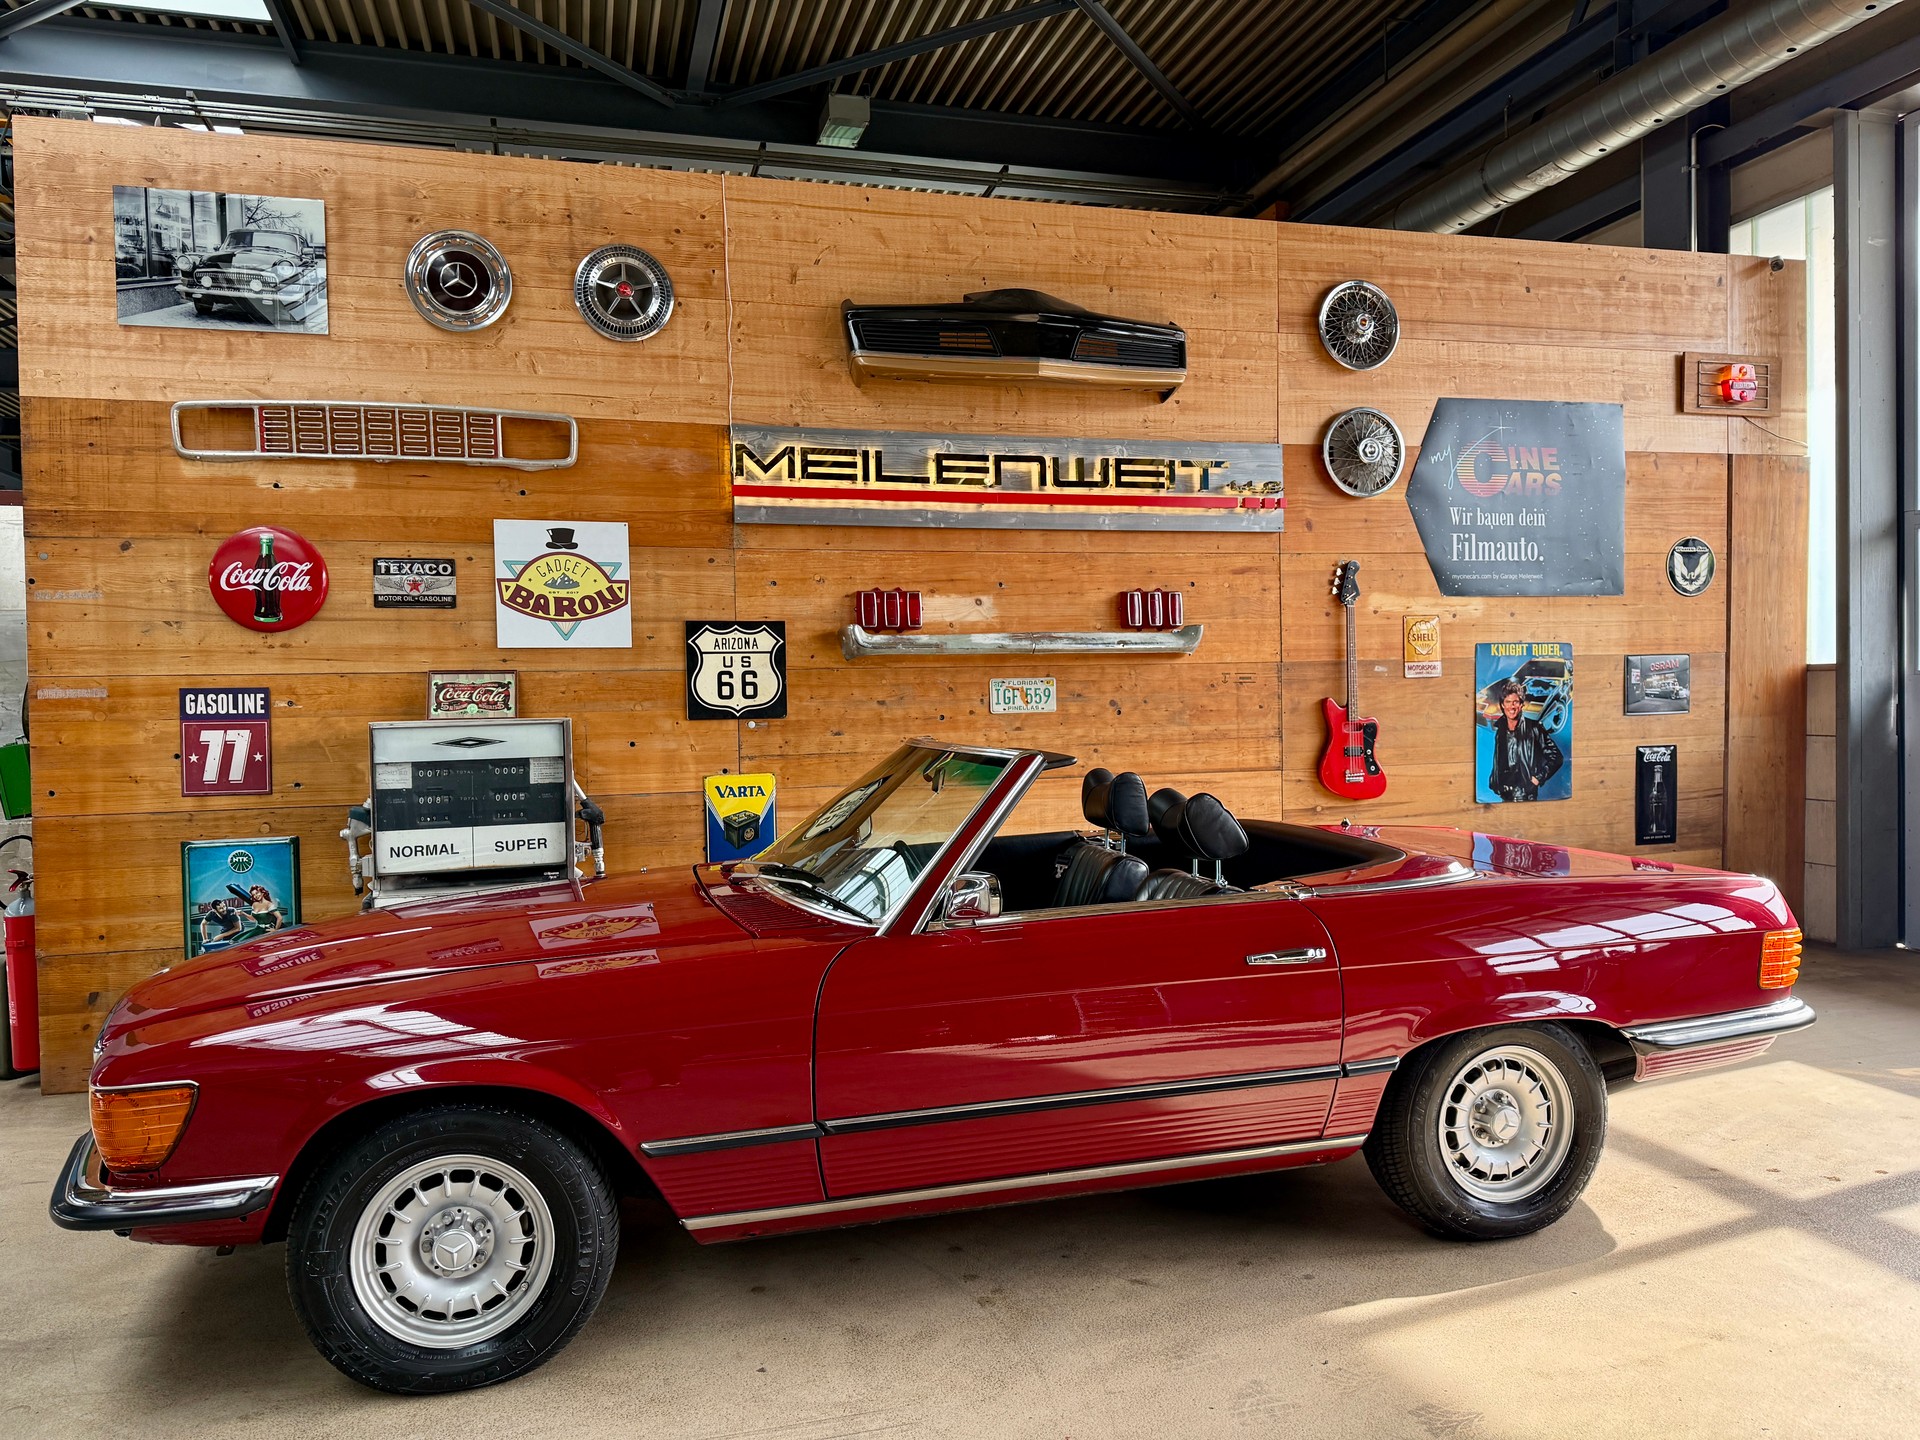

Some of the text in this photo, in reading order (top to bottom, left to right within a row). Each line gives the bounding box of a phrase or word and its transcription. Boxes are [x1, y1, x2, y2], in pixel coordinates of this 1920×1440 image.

[735, 443, 1231, 491] MEILENWEIT
[1450, 507, 1546, 527] Wir bauen dein
[1450, 533, 1544, 562] Filmauto.
[220, 561, 313, 592] Coca-Cola
[377, 561, 452, 575] TEXACO
[535, 558, 590, 578] GADGET
[1492, 572, 1499, 580] by
[505, 583, 624, 617] BARON
[714, 637, 759, 650] ARIZONA
[1412, 633, 1435, 641] SHELL
[1491, 644, 1528, 656] KNIGHT
[1650, 658, 1680, 671] OSRAM
[717, 670, 758, 700] 66
[185, 693, 265, 715] GASOLINE
[1025, 687, 1051, 705] 559
[199, 730, 252, 784] 77
[715, 785, 766, 799] VARTA
[390, 838, 548, 858] NORMAL SUPER
